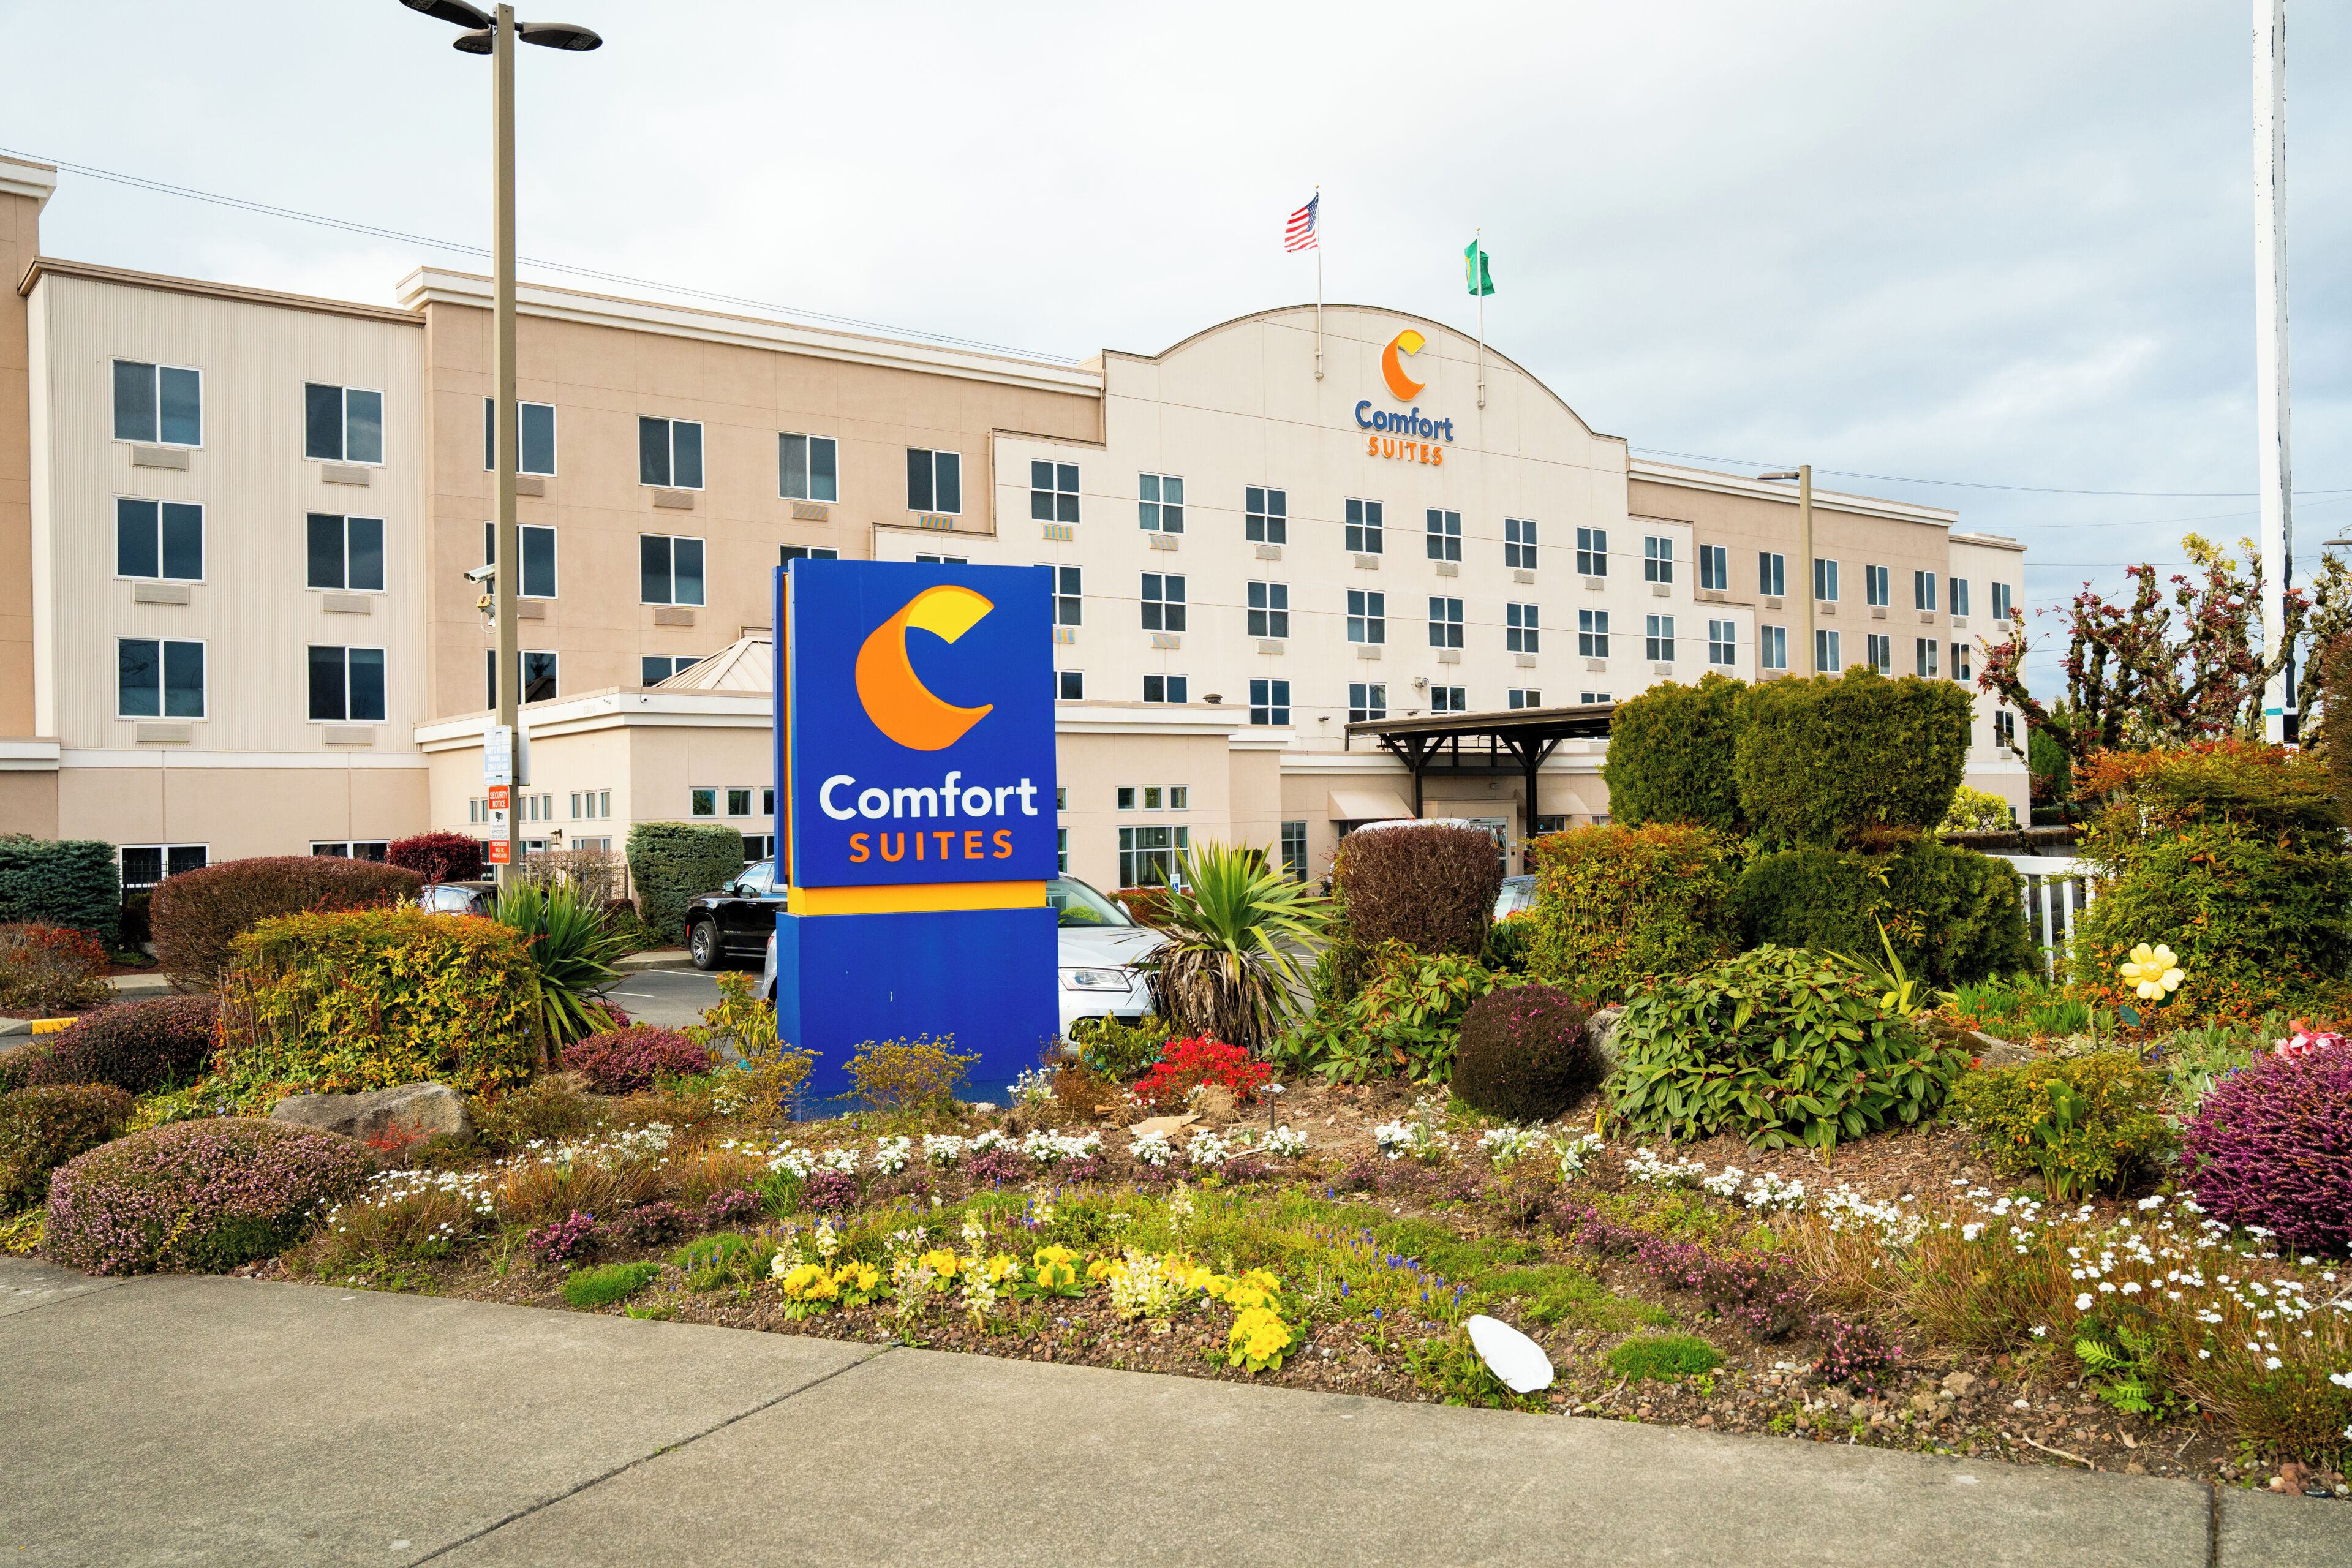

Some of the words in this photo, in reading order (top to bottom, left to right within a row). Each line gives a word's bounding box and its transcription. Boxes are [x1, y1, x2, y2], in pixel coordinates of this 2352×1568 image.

[1354, 400, 1453, 442] Comfort
[1367, 436, 1443, 466] SUITES
[819, 771, 1038, 820] Comfort
[849, 829, 1012, 863] SUITES
